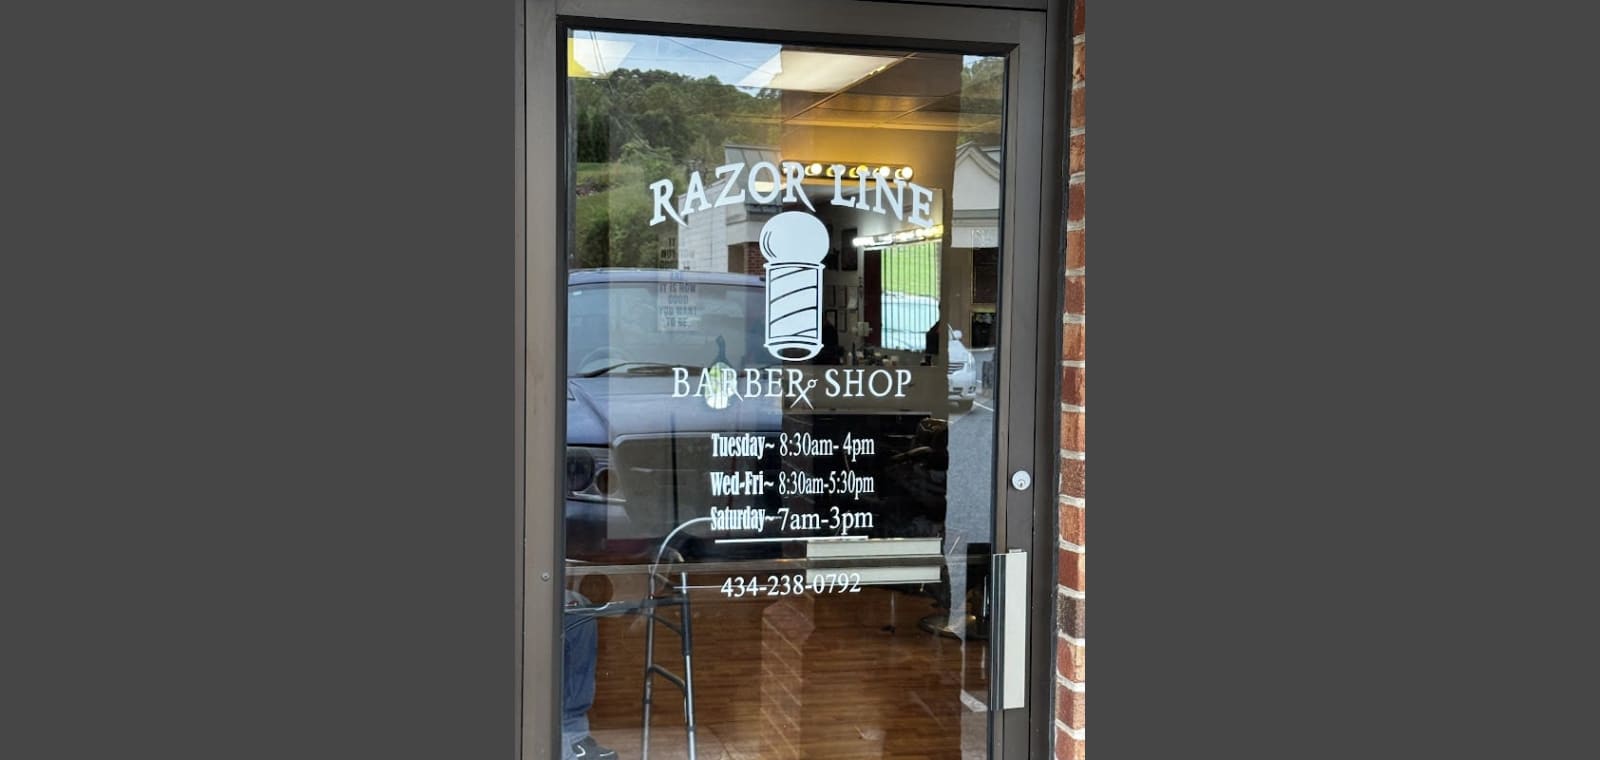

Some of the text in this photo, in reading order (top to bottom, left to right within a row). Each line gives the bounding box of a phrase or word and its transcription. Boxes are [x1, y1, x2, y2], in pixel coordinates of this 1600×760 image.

[649, 161, 934, 228] RAZOR LINE
[671, 367, 912, 409] BARBER SHOP
[842, 432, 875, 463] 4pm
[720, 573, 862, 598] 434-238-0792
